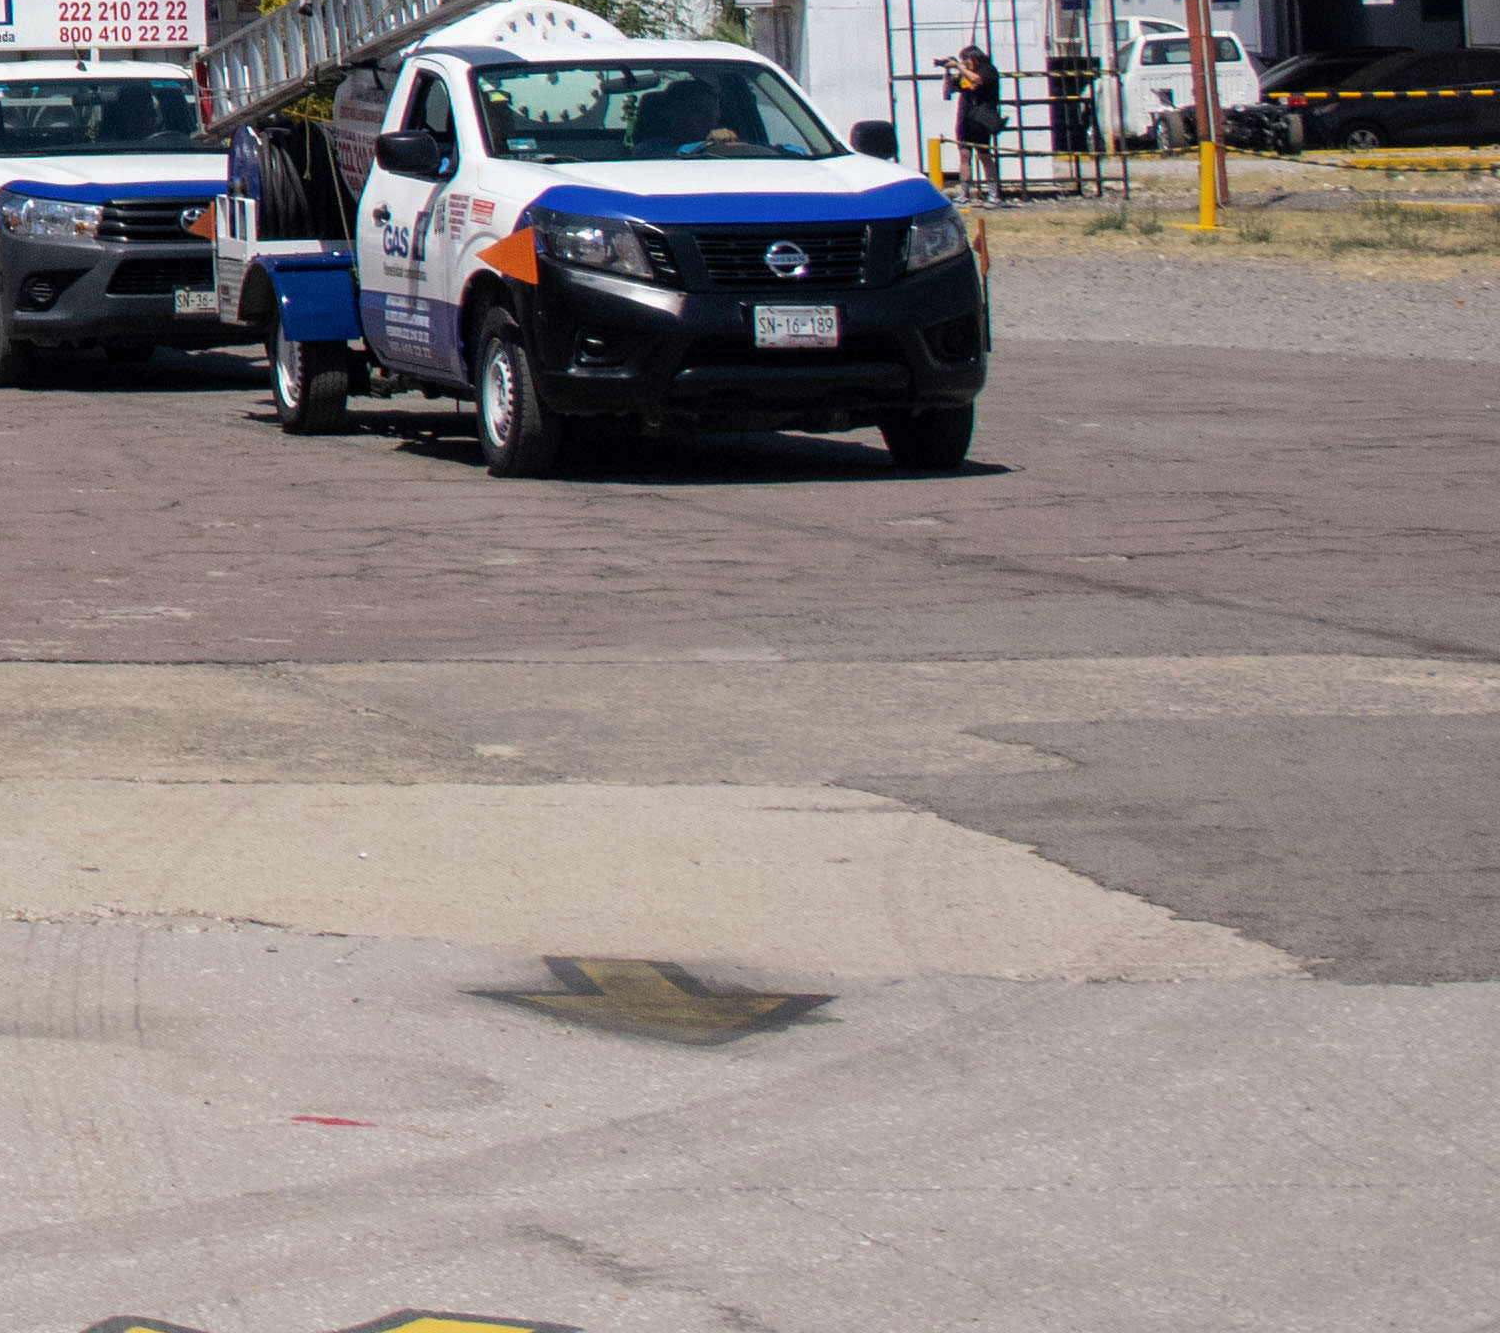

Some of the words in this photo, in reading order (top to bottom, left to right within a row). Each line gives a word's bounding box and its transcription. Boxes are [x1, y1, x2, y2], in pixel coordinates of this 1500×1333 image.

[58, 2, 92, 22] 222
[98, 1, 131, 21] 210
[137, 1, 159, 21] 22
[166, 1, 188, 20] 22
[59, 26, 92, 43] 800
[98, 26, 132, 42] 410
[138, 26, 160, 42] 22
[166, 25, 188, 41] 22
[383, 224, 409, 259] GAS
[759, 317, 834, 334] SN-16-189
